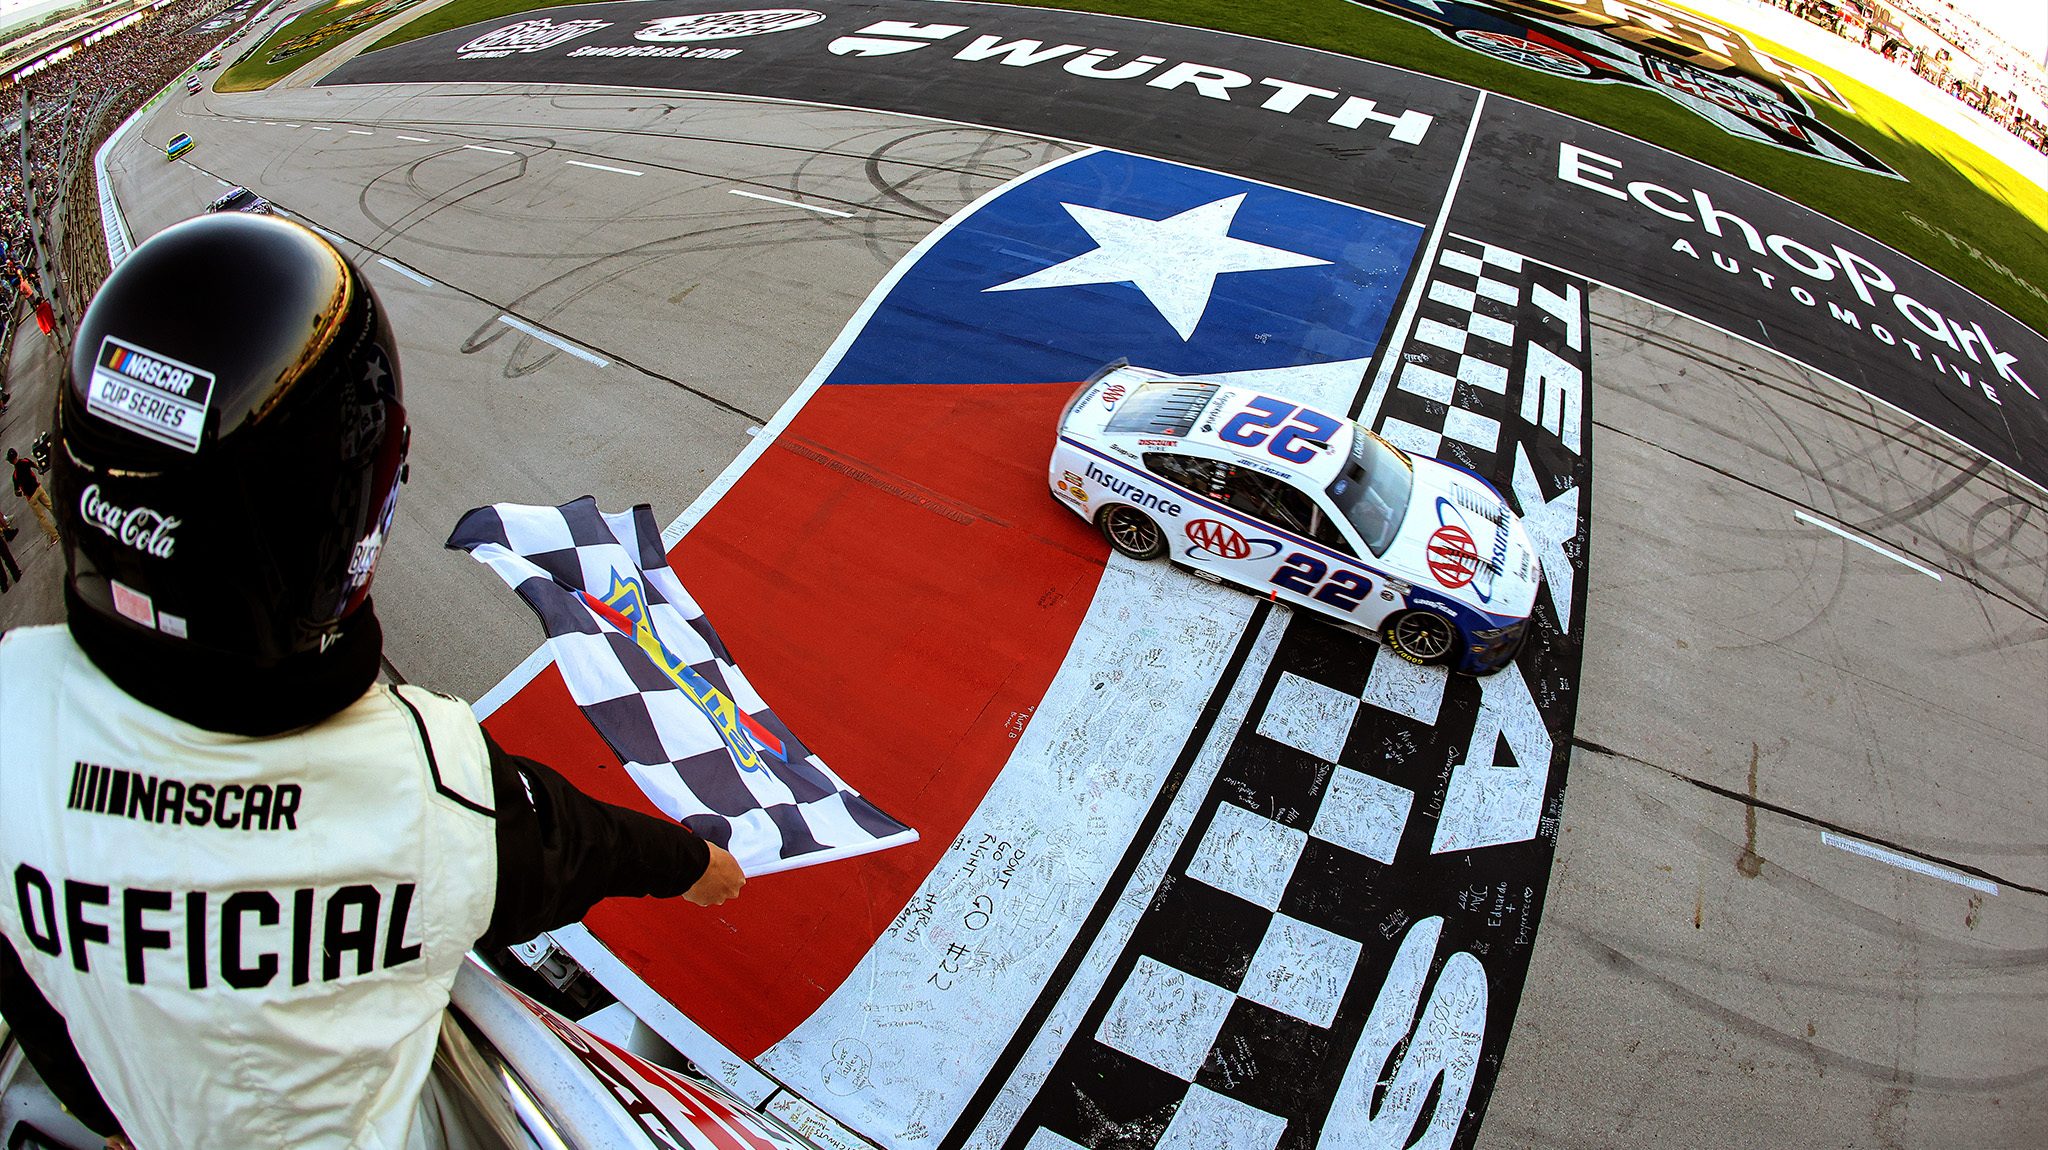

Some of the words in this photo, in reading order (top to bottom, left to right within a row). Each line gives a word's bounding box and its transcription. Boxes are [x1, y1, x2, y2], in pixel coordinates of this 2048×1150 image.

[953, 34, 1434, 146] WÜRTH
[1659, 71, 1796, 133] MOLY
[1557, 141, 2041, 401] EchoPark
[1671, 237, 2003, 406] AUTOMOTIVE
[101, 380, 130, 408] CUP
[128, 389, 187, 429] SERIES
[125, 352, 195, 397] NASCAR
[1219, 395, 1344, 464] 22
[1084, 461, 1182, 518] Insurance
[80, 483, 183, 560] Coca-Cola
[1186, 519, 1250, 559] AAA
[1490, 500, 1512, 578] Insurance
[1269, 552, 1373, 613] 22
[1428, 527, 1478, 588] AAA
[1387, 629, 1424, 665] GOODYEAR
[129, 768, 302, 831] NASCAR
[13, 861, 423, 990] OFFICIAL
